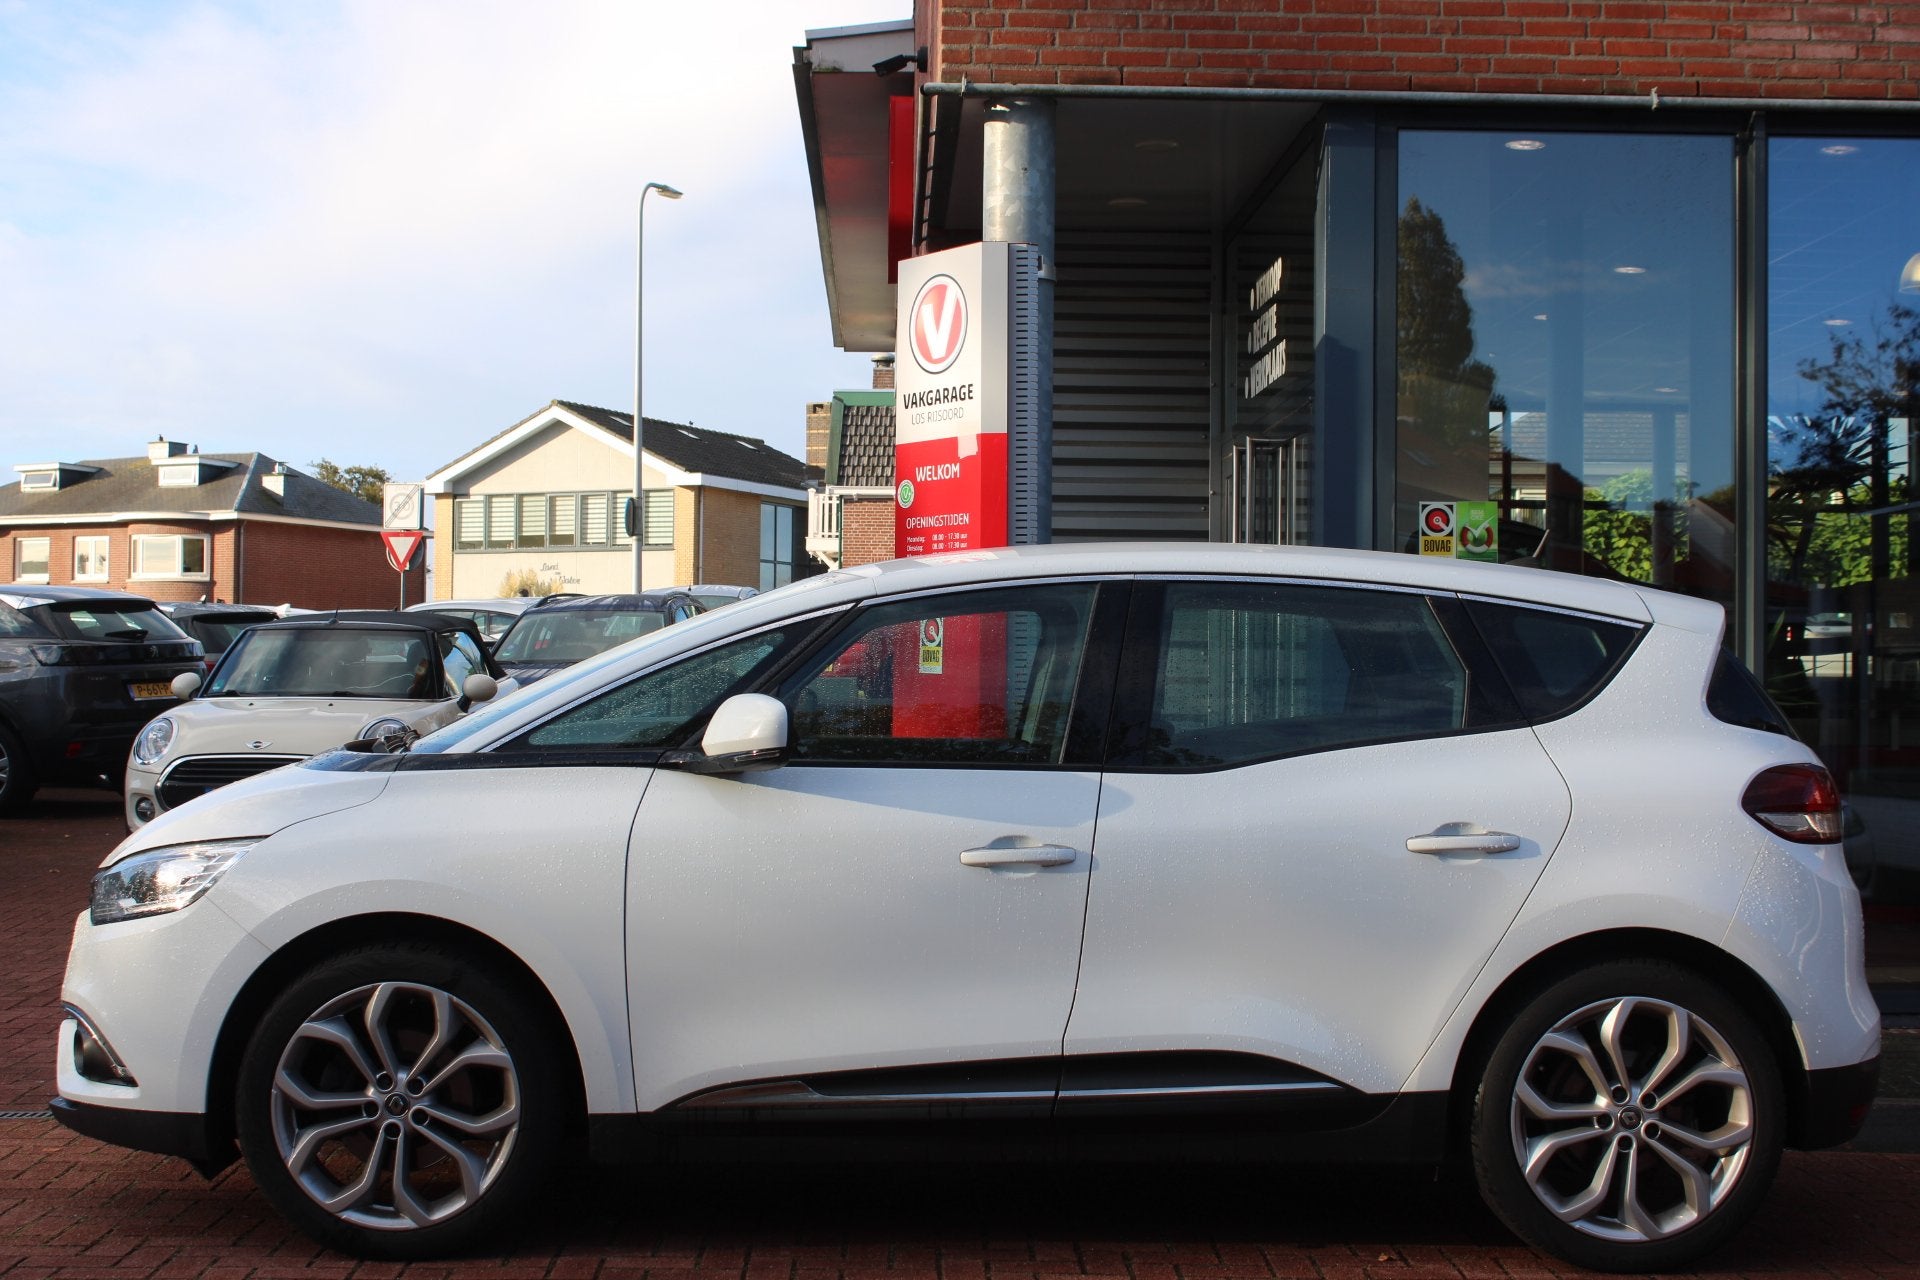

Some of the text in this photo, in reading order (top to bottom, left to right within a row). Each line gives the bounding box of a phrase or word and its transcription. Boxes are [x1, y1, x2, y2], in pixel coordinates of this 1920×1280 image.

[1256, 256, 1282, 310] VERKOOP
[1253, 303, 1277, 354] RECEPTIE
[1250, 338, 1287, 399] WERKPLAATS
[903, 383, 974, 410] VAKGARAGE
[911, 407, 964, 425] LOS RIJSOORD
[915, 463, 960, 482] WELKOM
[906, 513, 969, 529] OPENINGSTIJDEN
[1424, 540, 1451, 553] BOVAG
[137, 683, 175, 696] P-661-P
